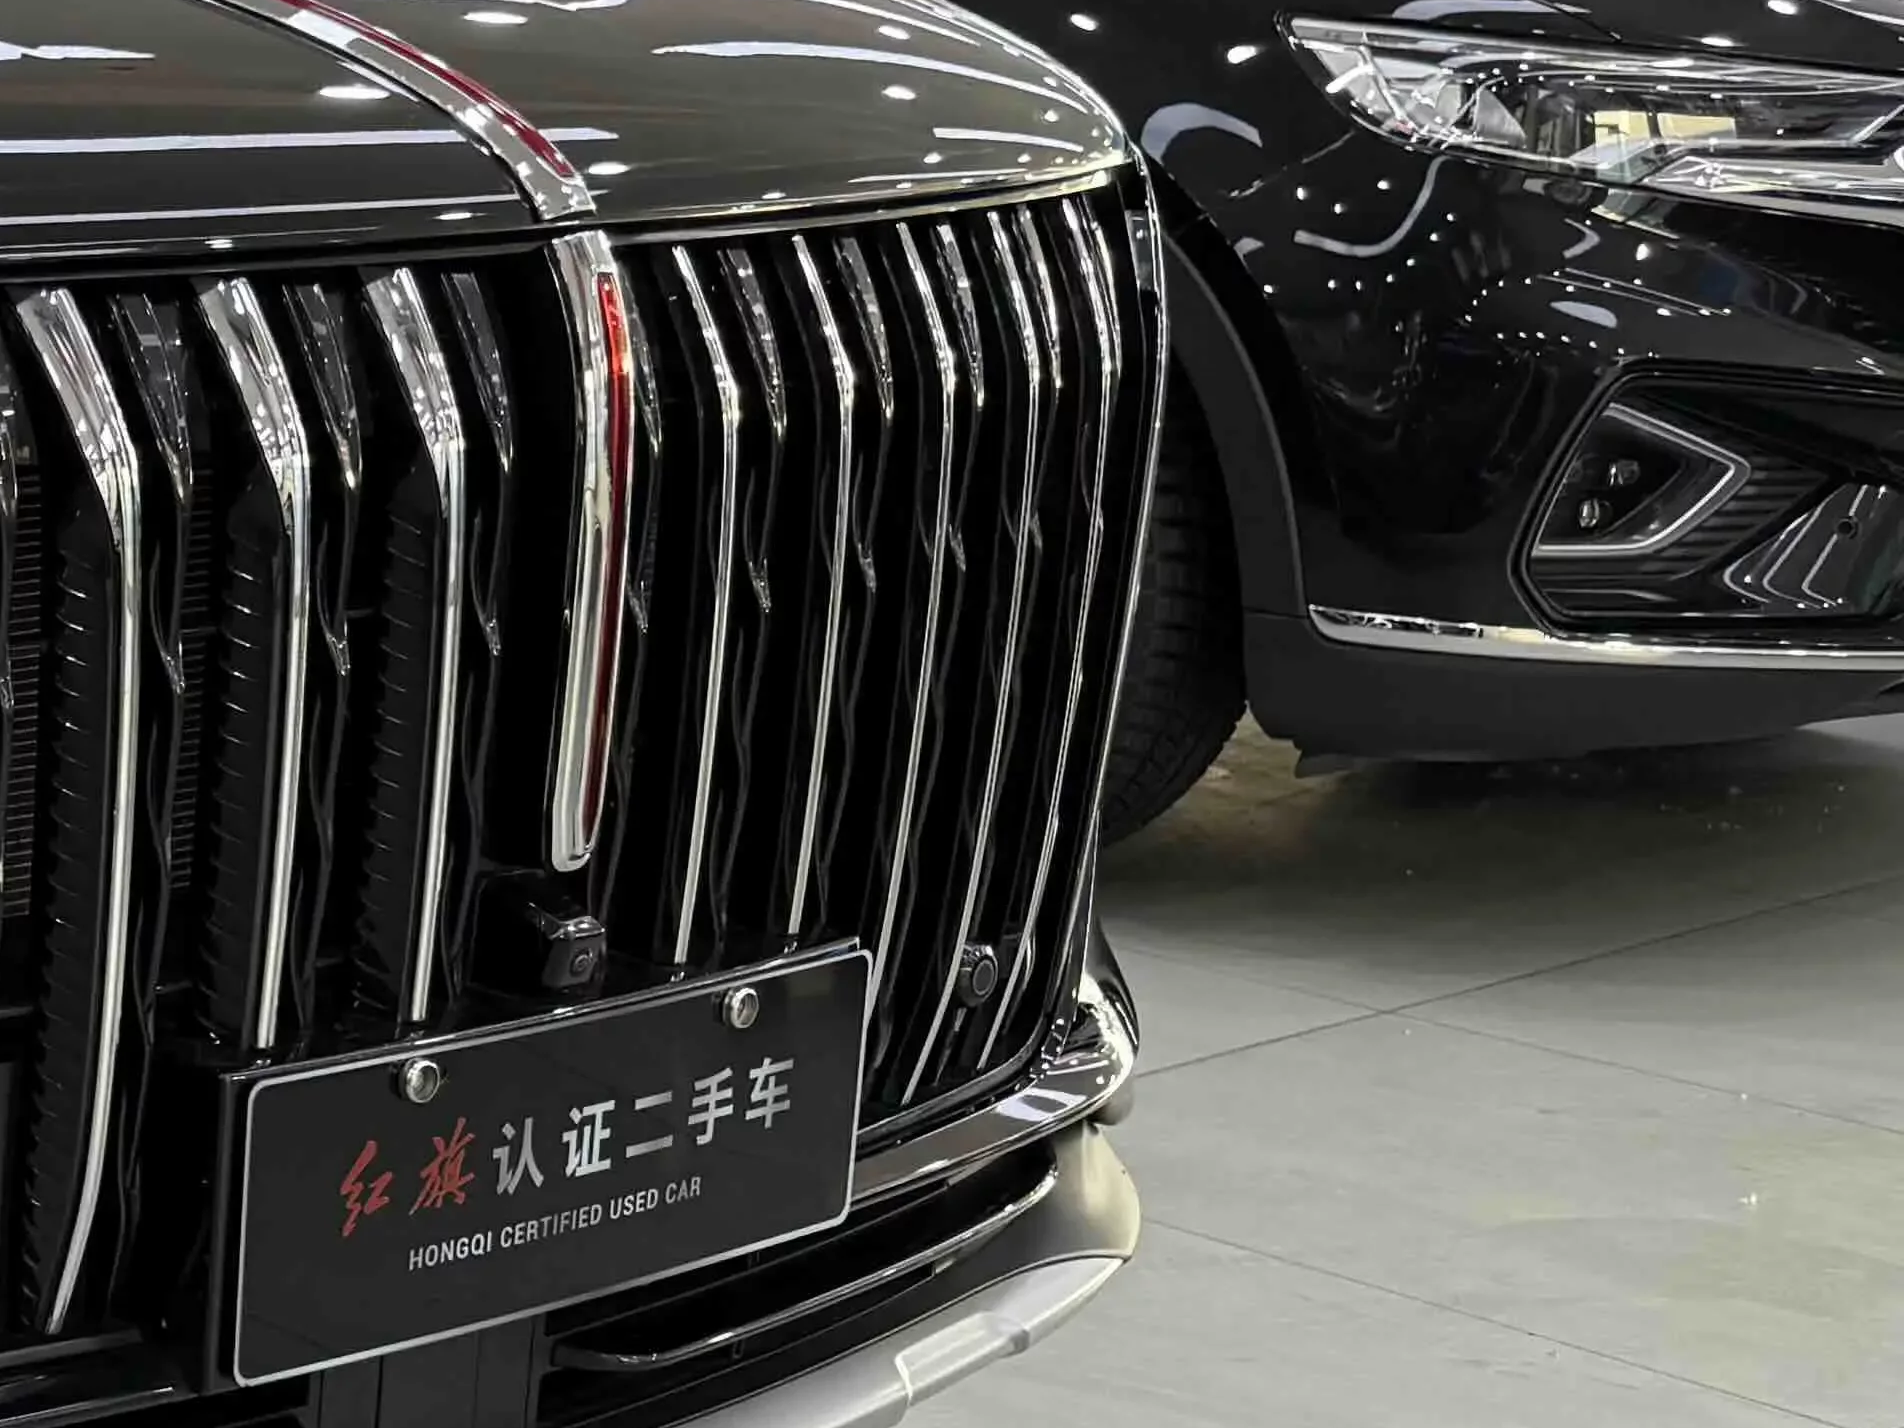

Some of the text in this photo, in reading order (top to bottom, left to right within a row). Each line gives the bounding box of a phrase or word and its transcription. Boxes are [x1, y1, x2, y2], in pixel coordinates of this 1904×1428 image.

[339, 1057, 795, 1237] 红旗认证二手车
[408, 1175, 703, 1271] HONGQI CERTIFIED USED CAR
